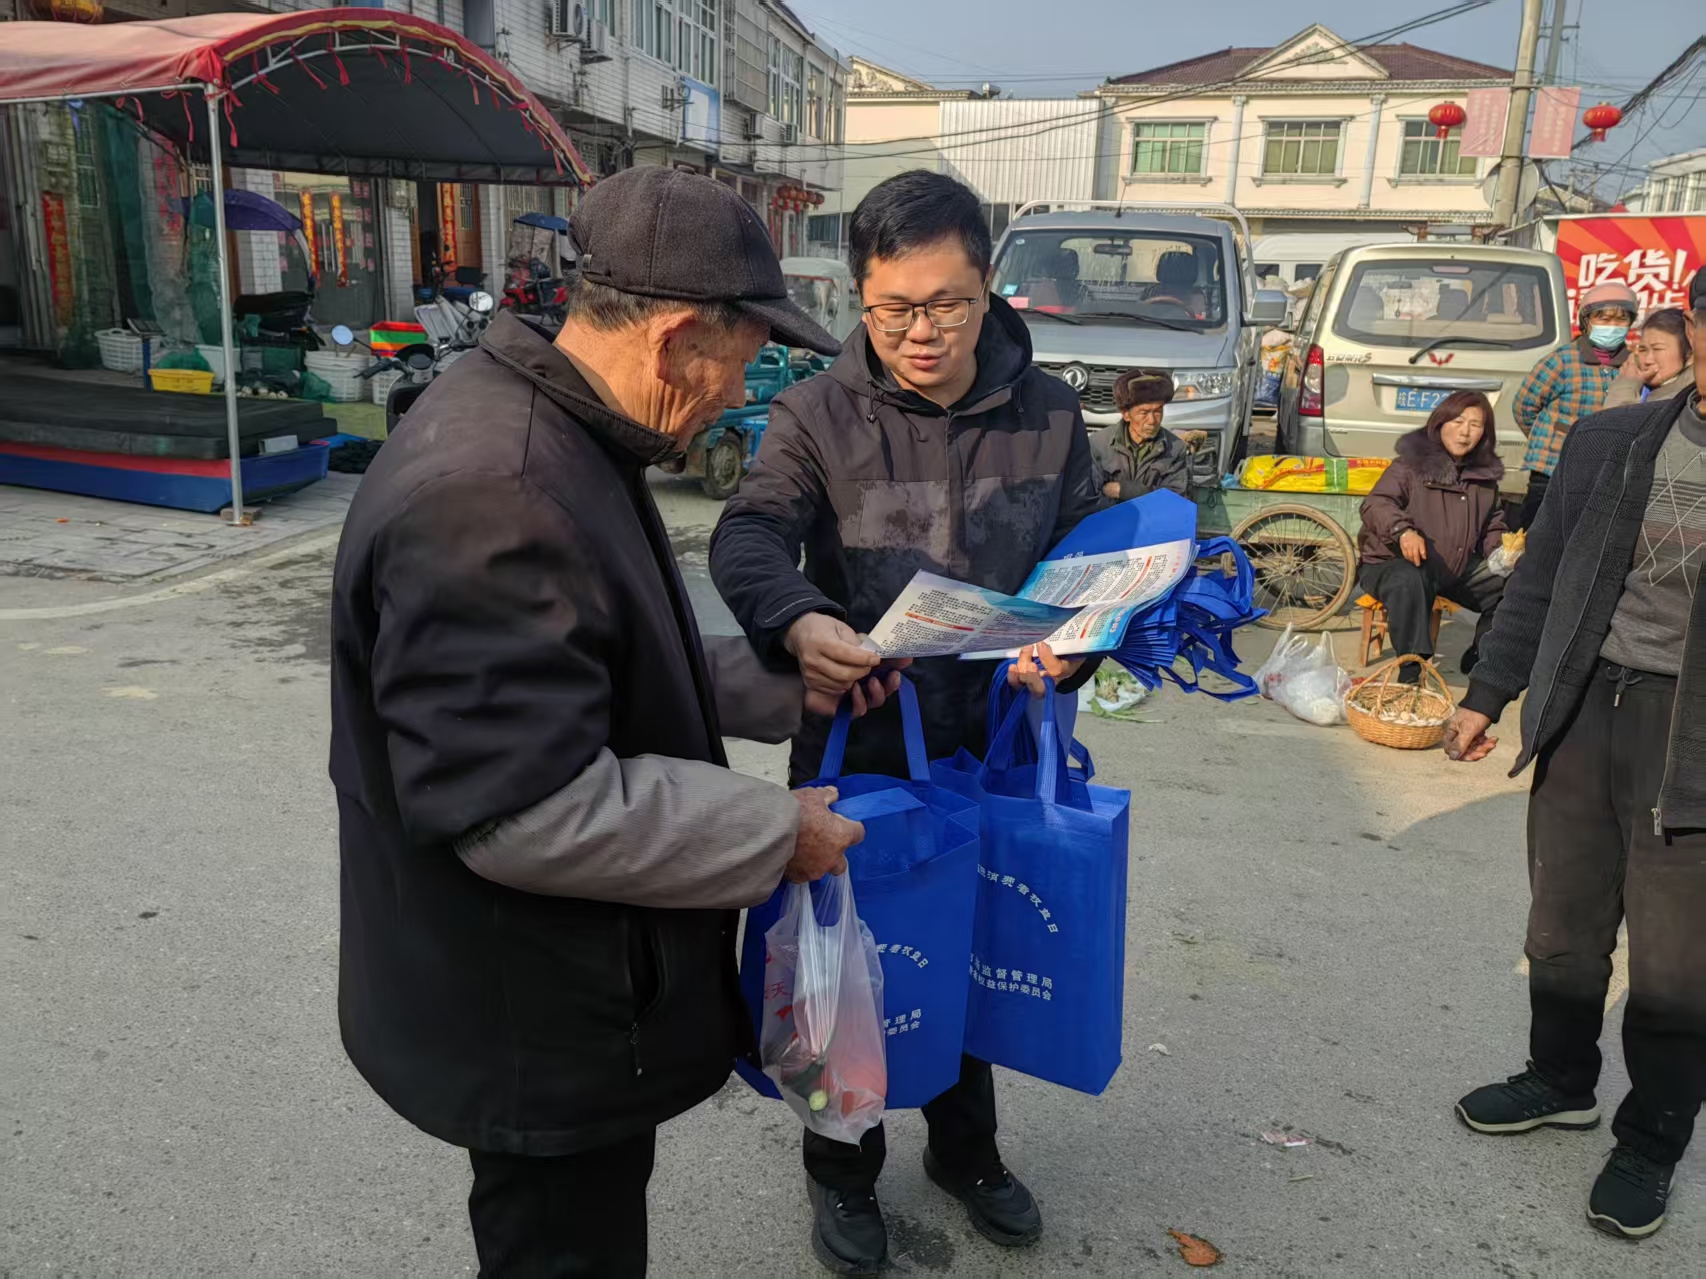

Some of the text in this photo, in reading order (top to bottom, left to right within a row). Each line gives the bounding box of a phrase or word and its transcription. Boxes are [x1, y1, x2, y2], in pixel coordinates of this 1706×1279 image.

[1578, 248, 1697, 292] 吃货!
[883, 1020, 920, 1036] 委员会
